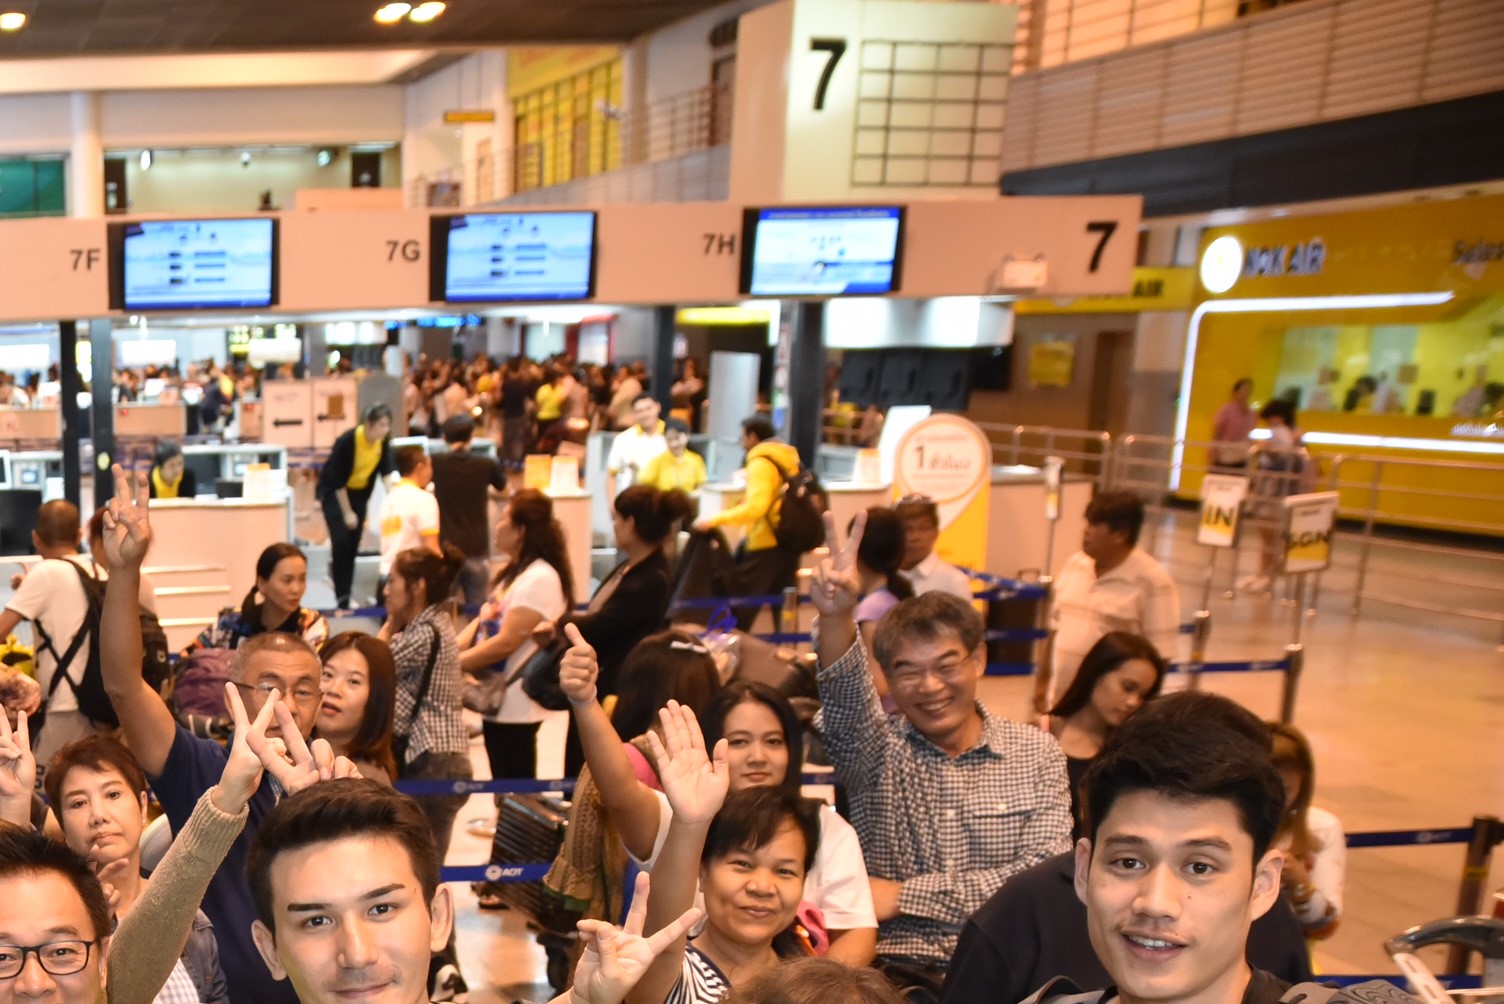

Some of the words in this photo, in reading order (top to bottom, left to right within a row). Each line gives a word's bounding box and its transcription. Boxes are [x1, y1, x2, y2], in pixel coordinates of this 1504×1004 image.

[809, 37, 846, 111] 7
[386, 240, 421, 262] 7G
[703, 233, 736, 255] 7H
[1084, 220, 1120, 273] 7
[70, 249, 101, 271] 7F
[1243, 244, 1285, 277] NOK
[1289, 241, 1326, 275] AIR
[1206, 505, 1234, 527] IN
[500, 867, 524, 877] AOT
